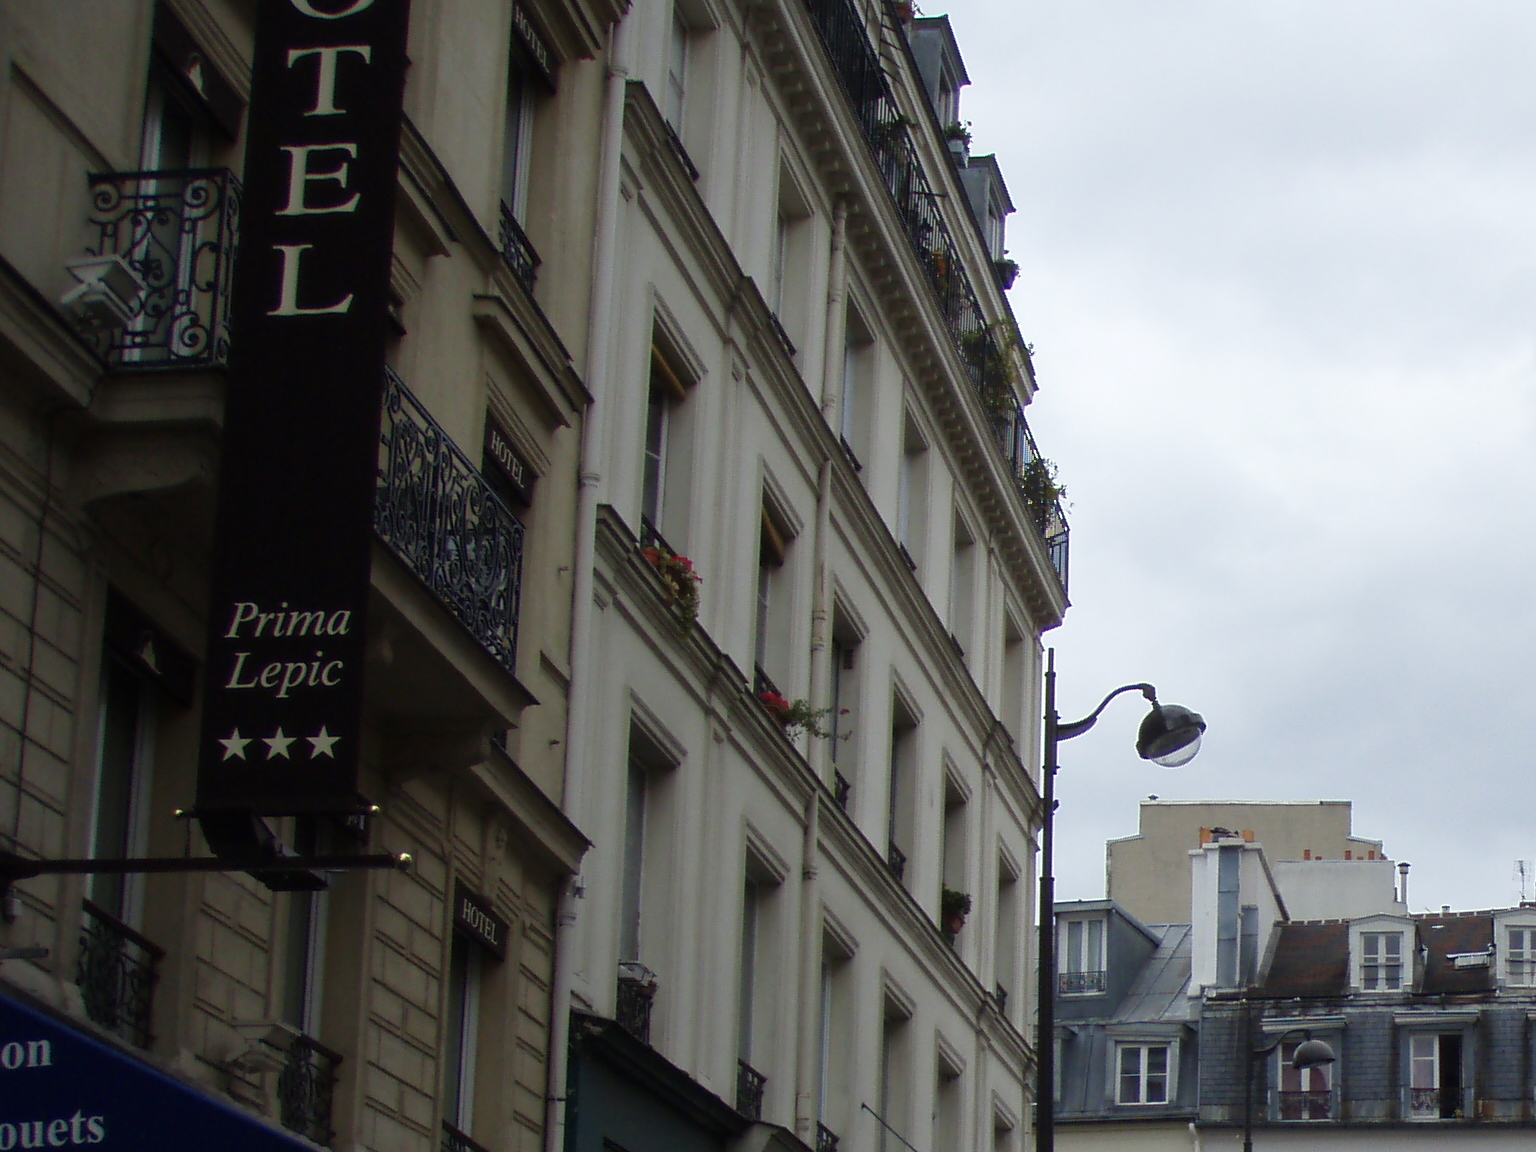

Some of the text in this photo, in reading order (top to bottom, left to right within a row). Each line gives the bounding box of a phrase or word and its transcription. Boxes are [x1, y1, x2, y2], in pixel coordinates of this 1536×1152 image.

[515, 4, 550, 74] HOTEL
[266, 0, 377, 317] TEL
[491, 430, 525, 489] HOTEL
[223, 601, 352, 639] Prima
[225, 650, 344, 699] Lepic
[462, 898, 498, 946] HOTEL
[0, 1109, 106, 1151] ouets
